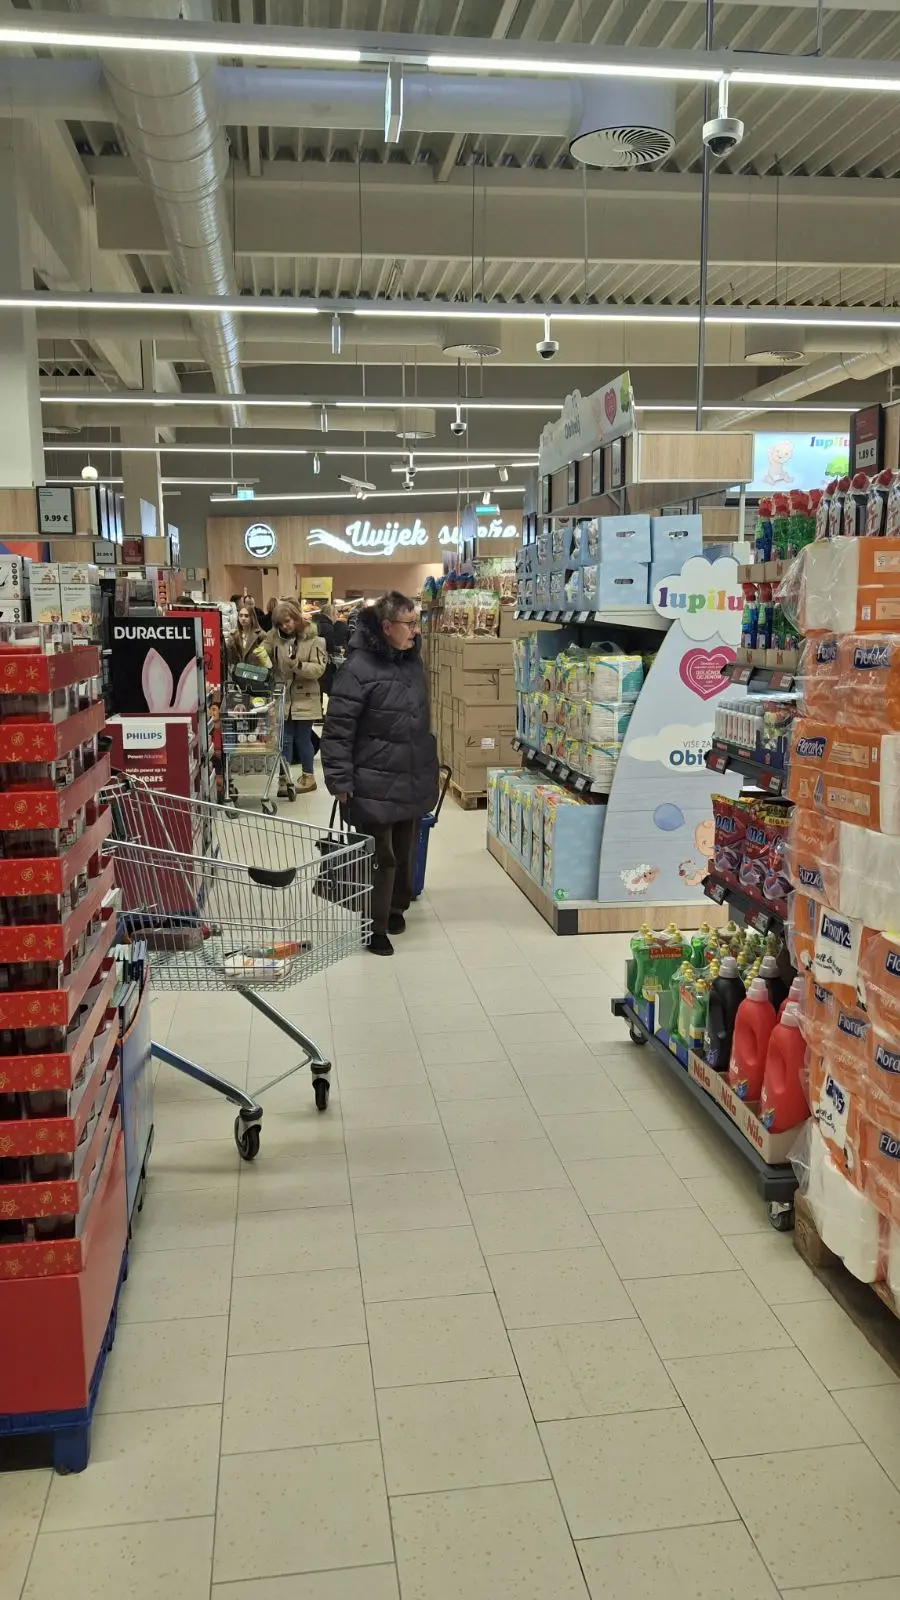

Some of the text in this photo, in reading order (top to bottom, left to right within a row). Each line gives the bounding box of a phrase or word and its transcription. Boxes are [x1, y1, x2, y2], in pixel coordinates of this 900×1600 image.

[345, 518, 428, 555] Uvijek
[658, 587, 745, 613] lupilu
[113, 626, 191, 639] DURACELL
[126, 732, 163, 740] PHILIPS
[683, 740, 700, 748] VIŠE
[701, 740, 711, 748] ZA
[693, 1059, 711, 1088] Nila
